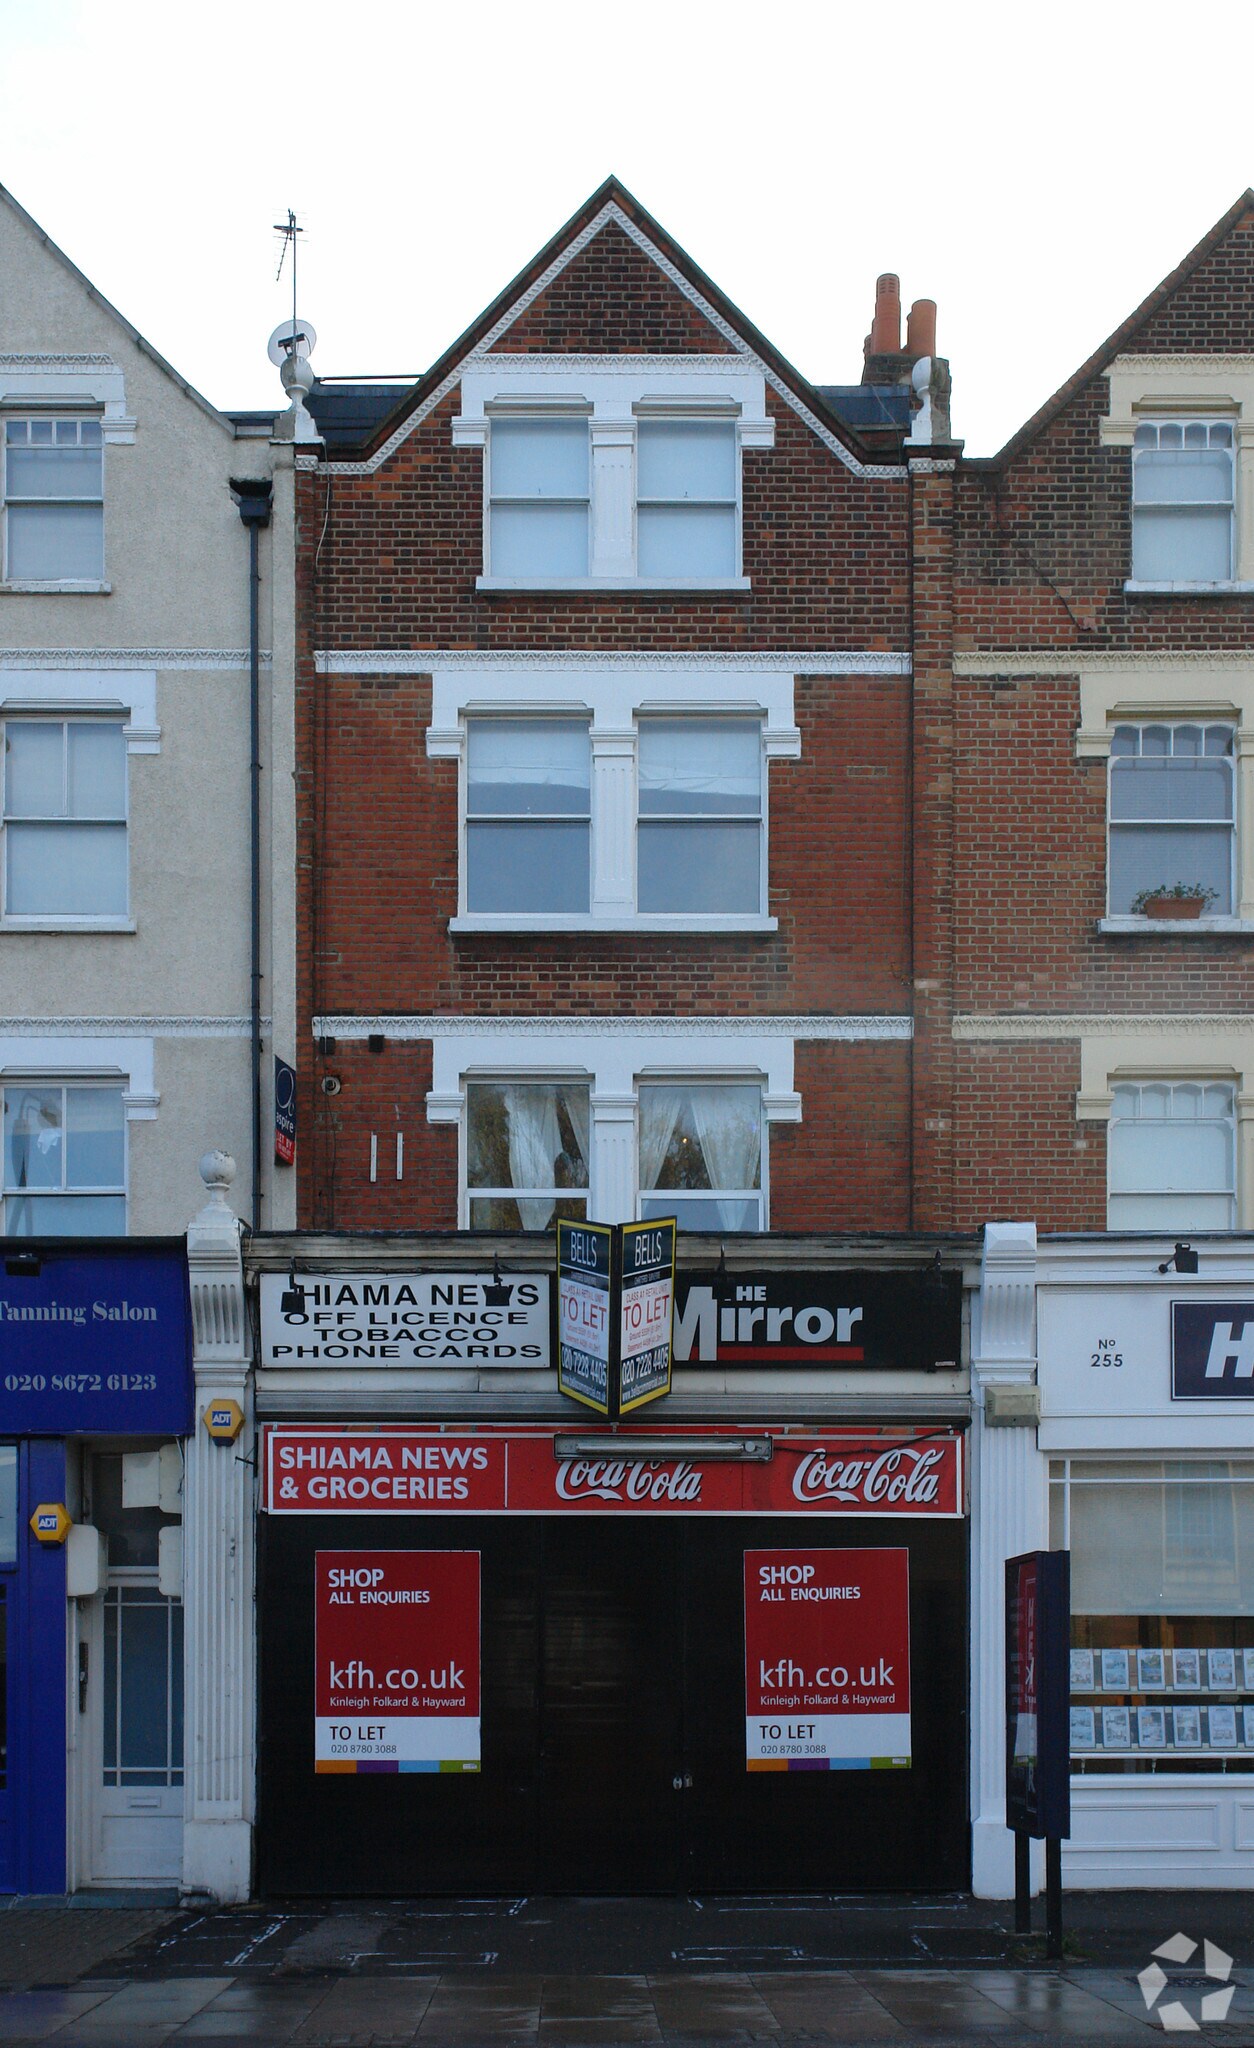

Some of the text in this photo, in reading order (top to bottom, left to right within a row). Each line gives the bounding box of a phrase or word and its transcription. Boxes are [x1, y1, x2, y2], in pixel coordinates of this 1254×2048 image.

[571, 1231, 597, 1267] BELLS
[635, 1231, 662, 1267] BELLS
[299, 1284, 418, 1306] HIAMA
[725, 1286, 767, 1302] HE
[92, 1301, 157, 1321] Salon
[284, 1312, 528, 1325] OFF LICENCE
[561, 1294, 606, 1331] TO LET
[624, 1295, 669, 1331] TO LET
[672, 1286, 863, 1361] Mirror
[314, 1329, 498, 1342] TOBACCO
[272, 1345, 542, 1358] PHONE CARDS
[1091, 1354, 1123, 1367] 255
[573, 1352, 589, 1378] 7228
[622, 1346, 669, 1385] 020 7228 4405
[5, 1374, 157, 1393] 020 8672 6123
[212, 1412, 231, 1424] ADT
[279, 1446, 489, 1470] SHIAMA NEWS
[792, 1448, 945, 1503] Coca-Cola
[279, 1476, 468, 1500] & GROCERIES
[38, 1517, 57, 1528] ADT
[328, 1569, 384, 1588] SHOP
[759, 1566, 815, 1585] SHOP
[329, 1590, 430, 1605] ALL ENQUIRIES
[760, 1587, 861, 1602] ALL ENQUIRIES
[330, 1660, 465, 1689] kfh.co.uk
[759, 1658, 895, 1688] kfh.co.uk
[330, 1697, 465, 1710] Kinleigh Folkard & Hayward
[760, 1694, 895, 1708] Kinleigh Folkard & Hayward
[330, 1726, 386, 1740] TO LET
[760, 1725, 816, 1739] TO LET
[331, 1745, 397, 1754] 020 8780 3088
[761, 1744, 826, 1754] 020 8780 3088
